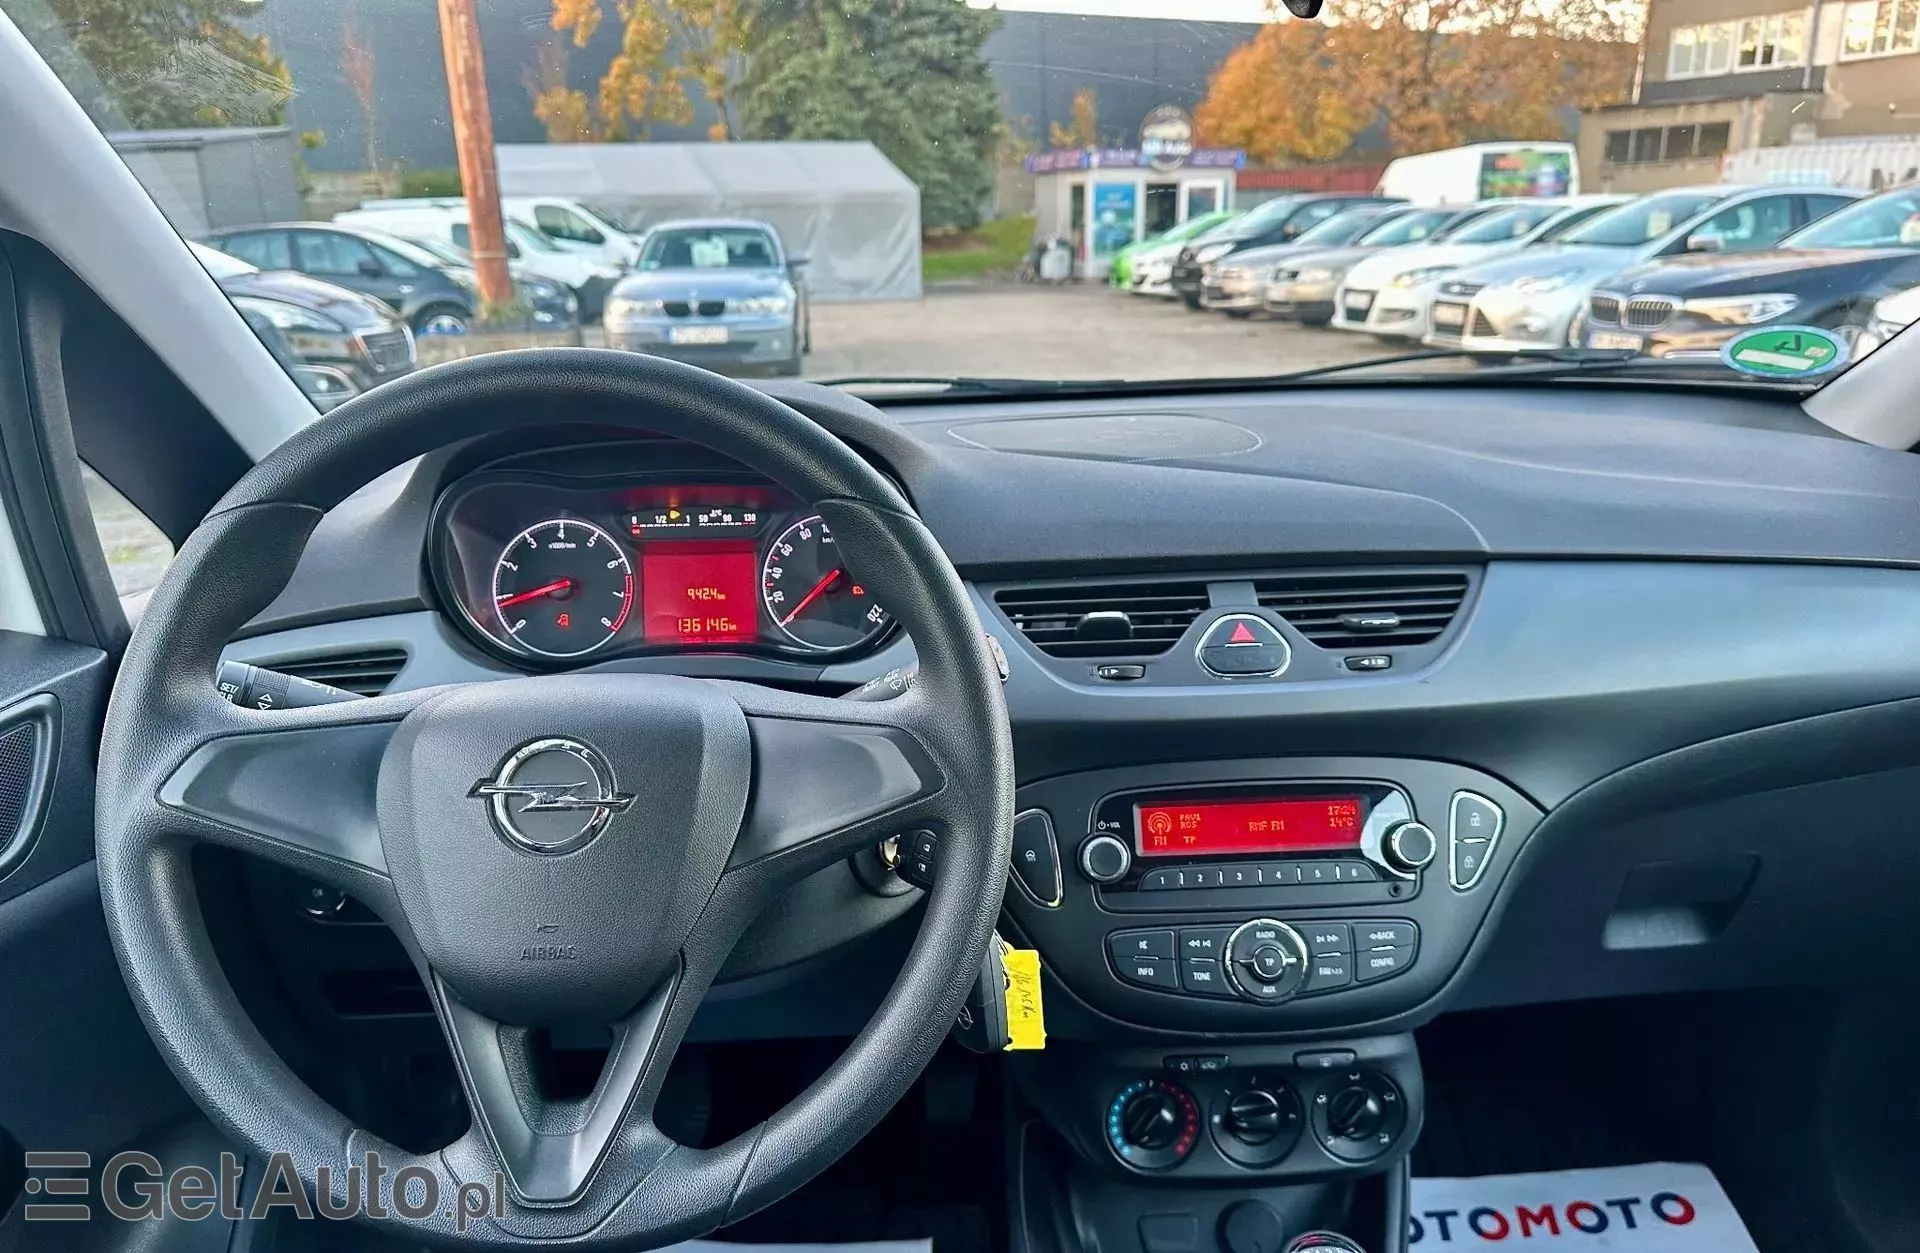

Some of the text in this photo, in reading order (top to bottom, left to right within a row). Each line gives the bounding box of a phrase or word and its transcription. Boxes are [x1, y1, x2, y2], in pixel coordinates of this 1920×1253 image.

[631, 516, 638, 524] 0
[655, 515, 667, 524] 1/2
[699, 513, 757, 523] 50 90 130
[557, 528, 565, 540] 4
[799, 528, 812, 540] 80
[527, 538, 538, 548] 3
[587, 536, 597, 548] 5
[780, 543, 794, 557] 60
[507, 561, 519, 572] 2
[607, 560, 619, 569] 6
[772, 567, 783, 579] 40
[772, 590, 785, 603] 20
[867, 603, 883, 622] 220
[515, 618, 527, 629] 0
[600, 617, 612, 627] 8
[1271, 820, 1285, 831] FM
[1154, 836, 1167, 846] FM
[1236, 872, 1243, 881] 3
[1275, 870, 1282, 879] 4
[1314, 869, 1322, 878] 5
[1351, 868, 1358, 877] 6
[1197, 874, 1204, 882] 2
[1256, 931, 1276, 939] RADIO
[1264, 958, 1275, 967] TP
[1370, 957, 1395, 967] CONFIG
[1137, 967, 1154, 976] INFO
[1192, 972, 1211, 981] TONE
[1262, 985, 1277, 993] AUX
